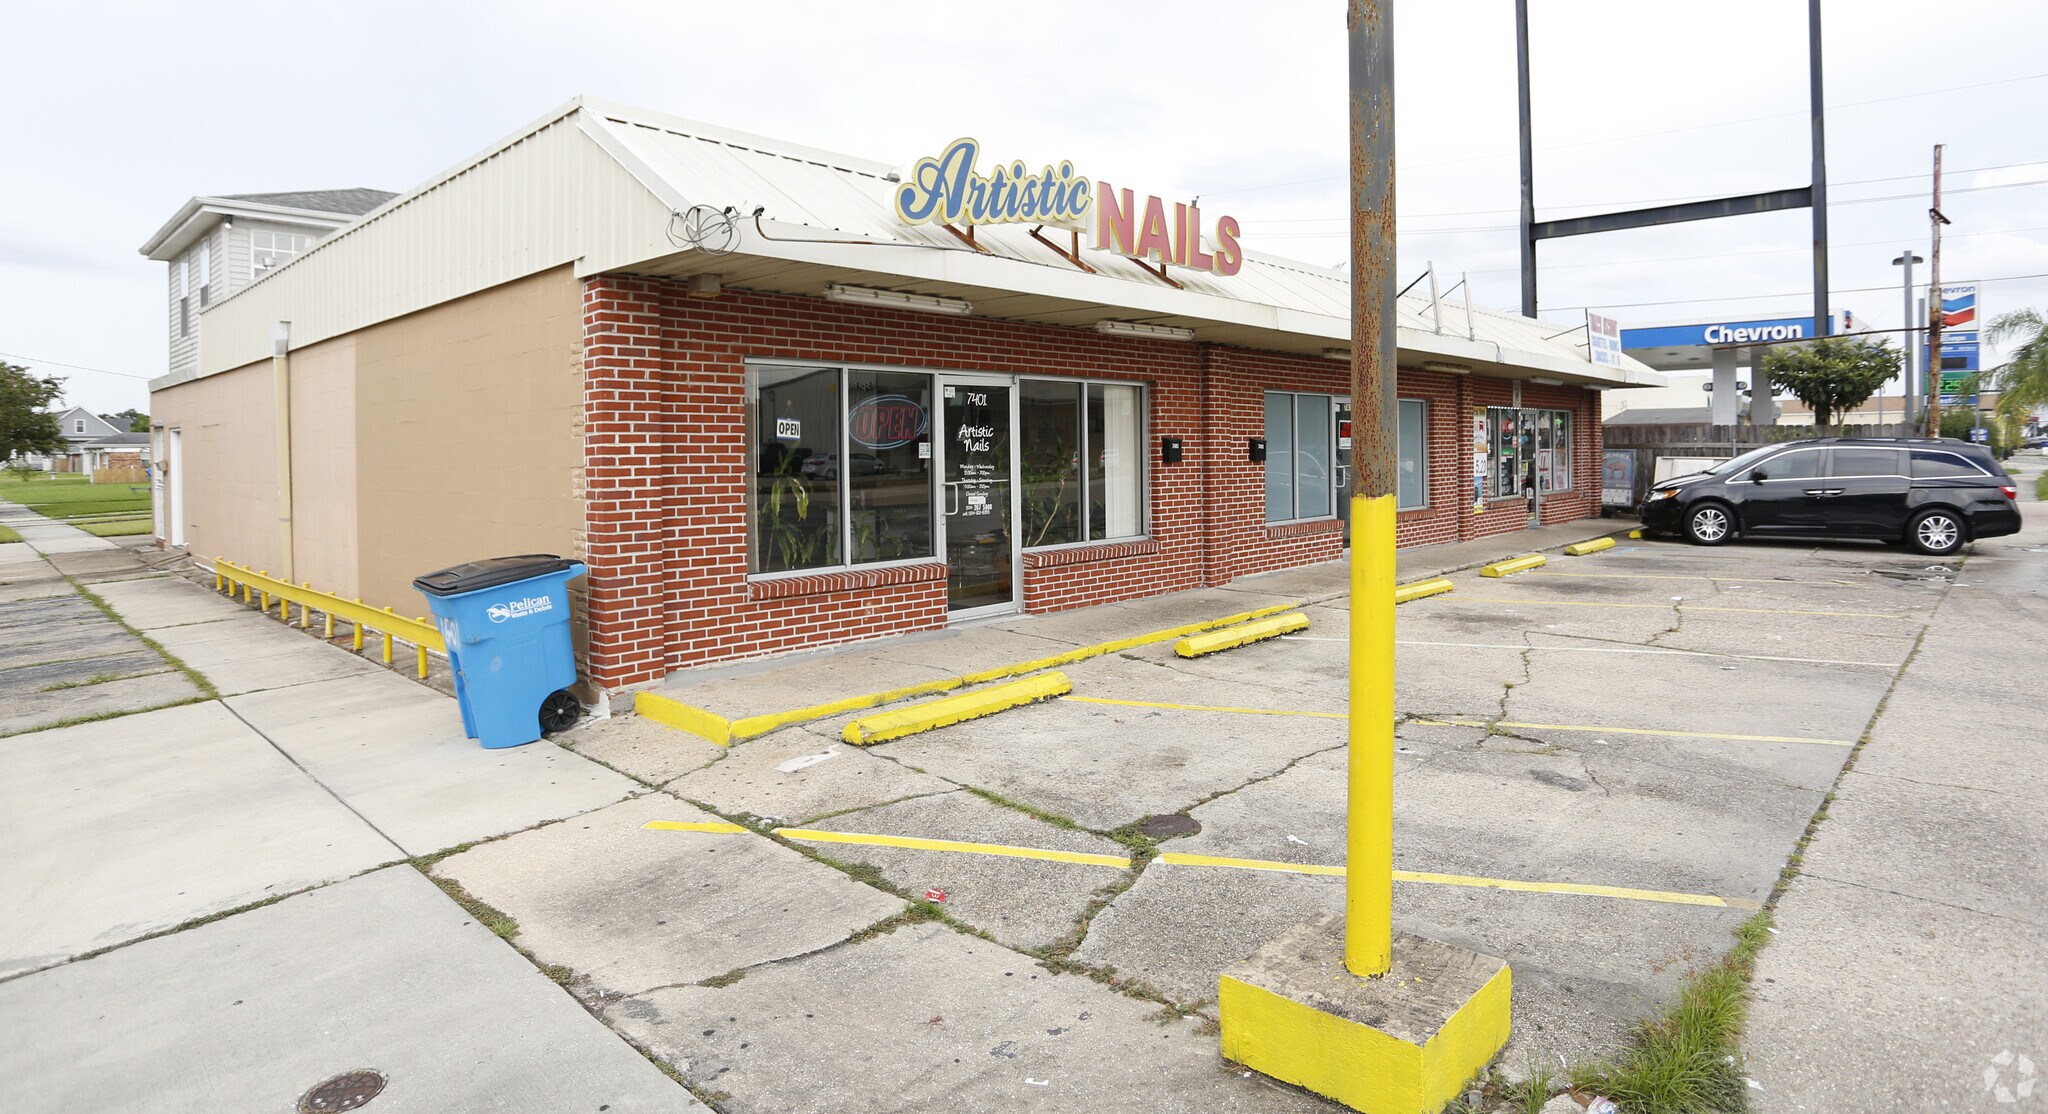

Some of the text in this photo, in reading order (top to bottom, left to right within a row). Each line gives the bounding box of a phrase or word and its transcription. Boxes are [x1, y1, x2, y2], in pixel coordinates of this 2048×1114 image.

[900, 140, 1242, 276] Artistic NAILS
[1704, 324, 1803, 344] Chevron
[967, 392, 987, 406] 7401
[778, 422, 799, 436] OPEN
[855, 406, 918, 440] OPEN
[959, 424, 994, 438] Artistic
[963, 438, 990, 452] Nails
[510, 595, 550, 611] Pelican
[511, 610, 528, 618] Waste
[533, 604, 552, 613] Debris
